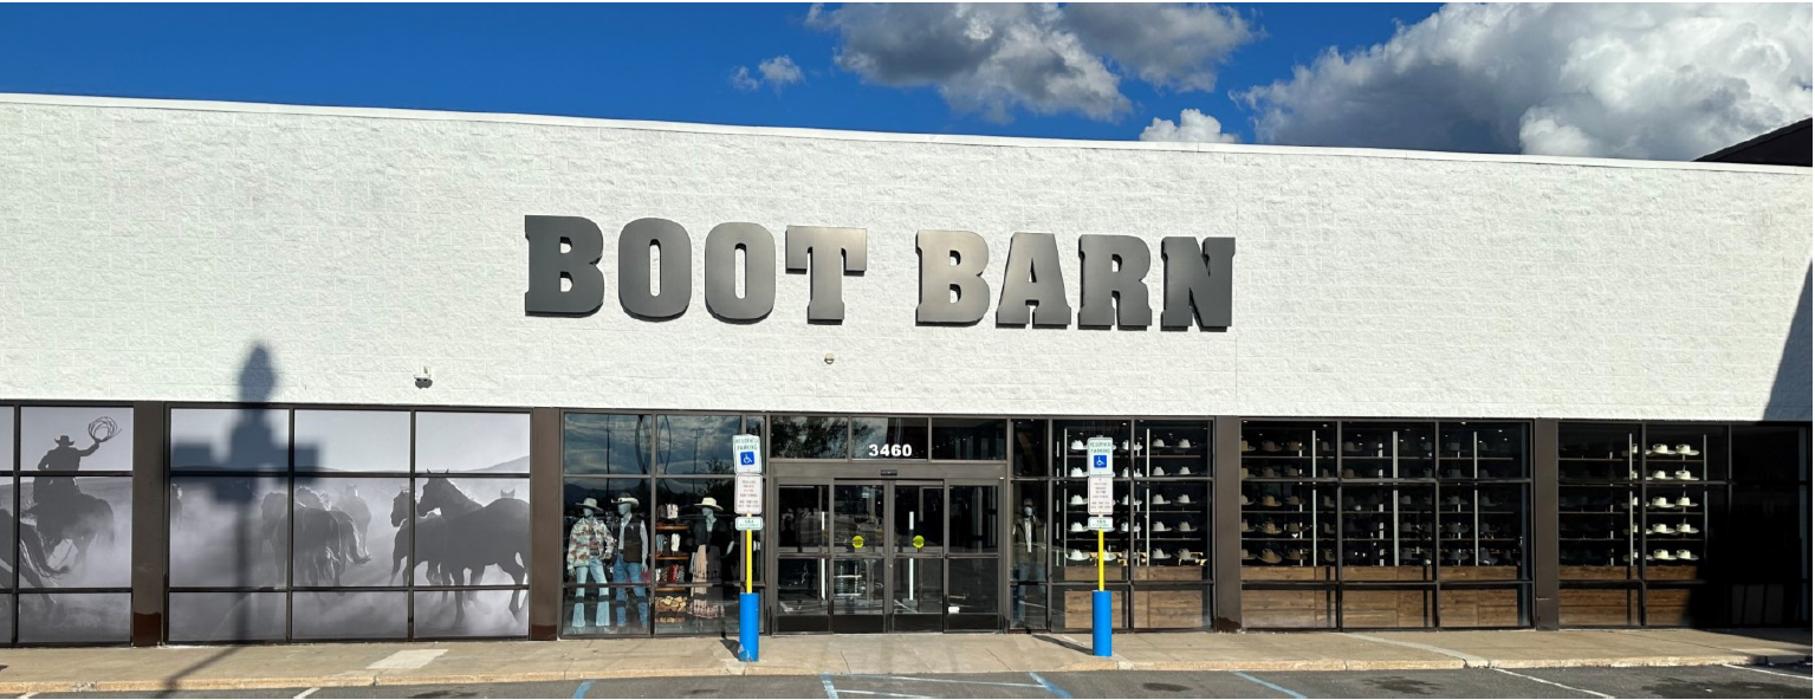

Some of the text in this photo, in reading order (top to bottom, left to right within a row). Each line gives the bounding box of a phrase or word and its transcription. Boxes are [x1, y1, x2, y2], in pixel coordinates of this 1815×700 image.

[525, 215, 1236, 329] BOOT BARN
[868, 443, 912, 457] 3460
